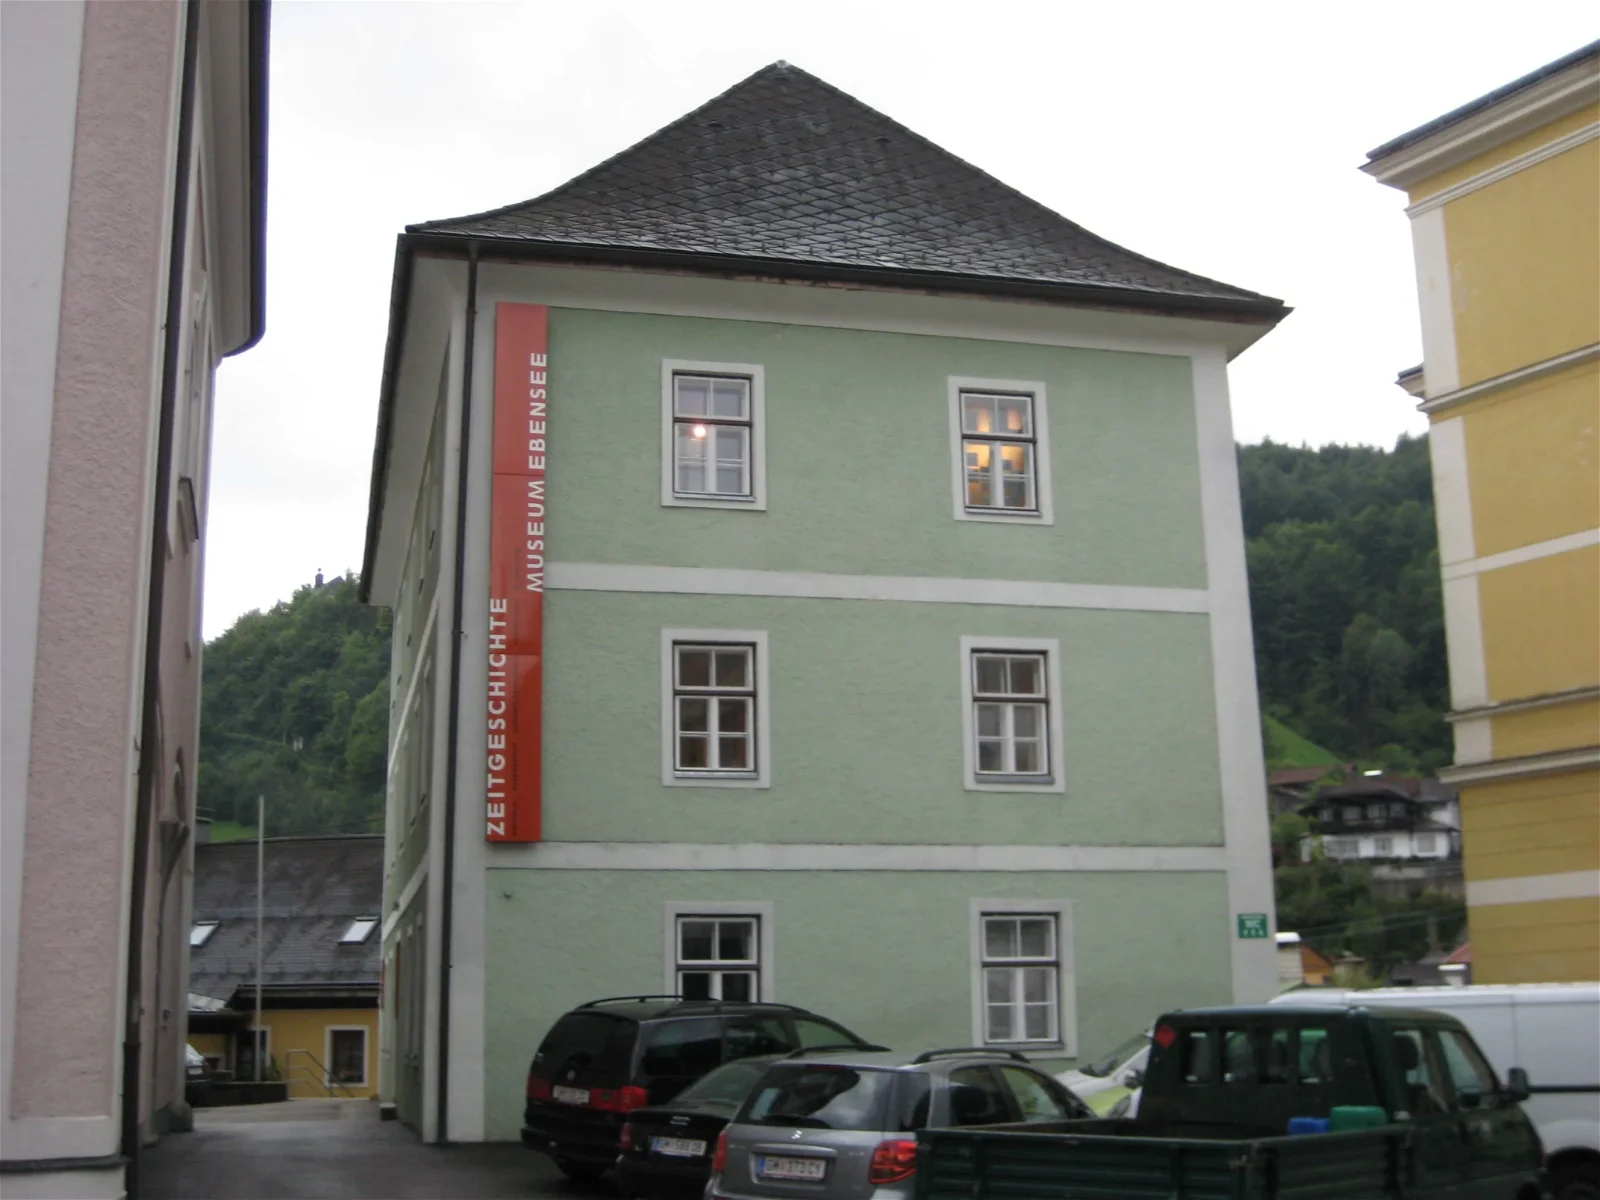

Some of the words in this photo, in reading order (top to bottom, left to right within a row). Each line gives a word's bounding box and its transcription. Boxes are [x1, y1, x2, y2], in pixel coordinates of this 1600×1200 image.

[528, 352, 548, 470] EBENSEE
[527, 480, 545, 593] MUSEUM
[487, 598, 508, 836] ZEITGESCHICHTE
